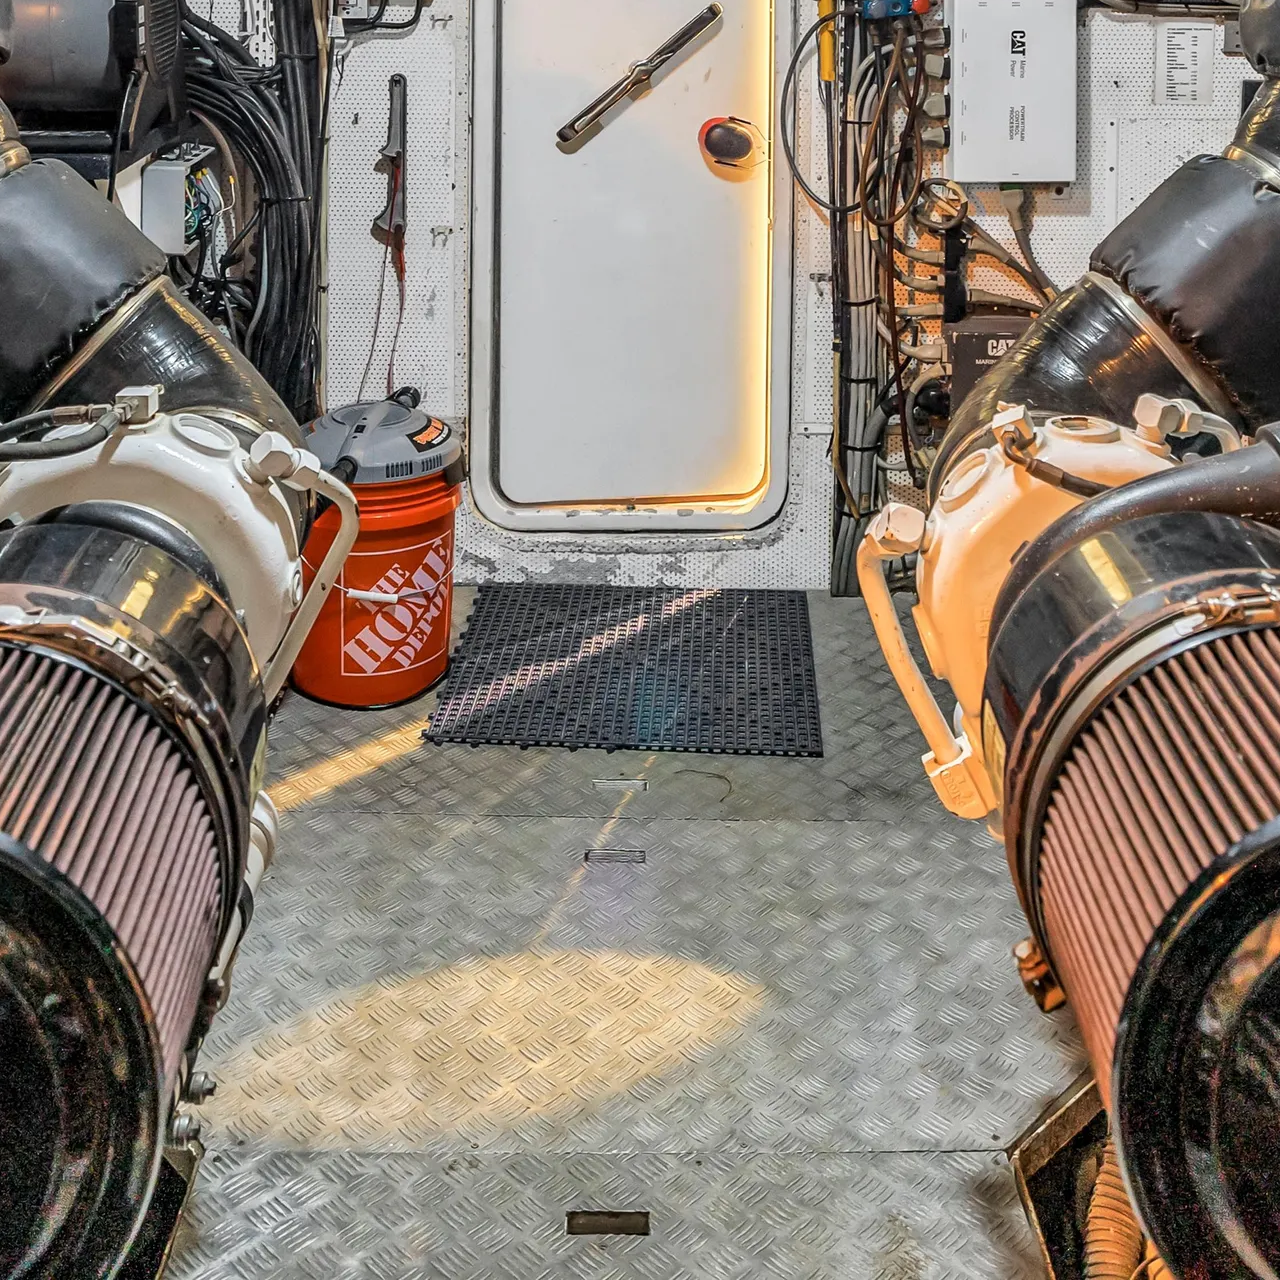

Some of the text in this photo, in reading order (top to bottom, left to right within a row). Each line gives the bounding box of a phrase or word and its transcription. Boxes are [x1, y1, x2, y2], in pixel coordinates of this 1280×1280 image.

[1010, 30, 1026, 56] CAT
[343, 538, 450, 675] HOME
[391, 579, 448, 669] DEPOT
